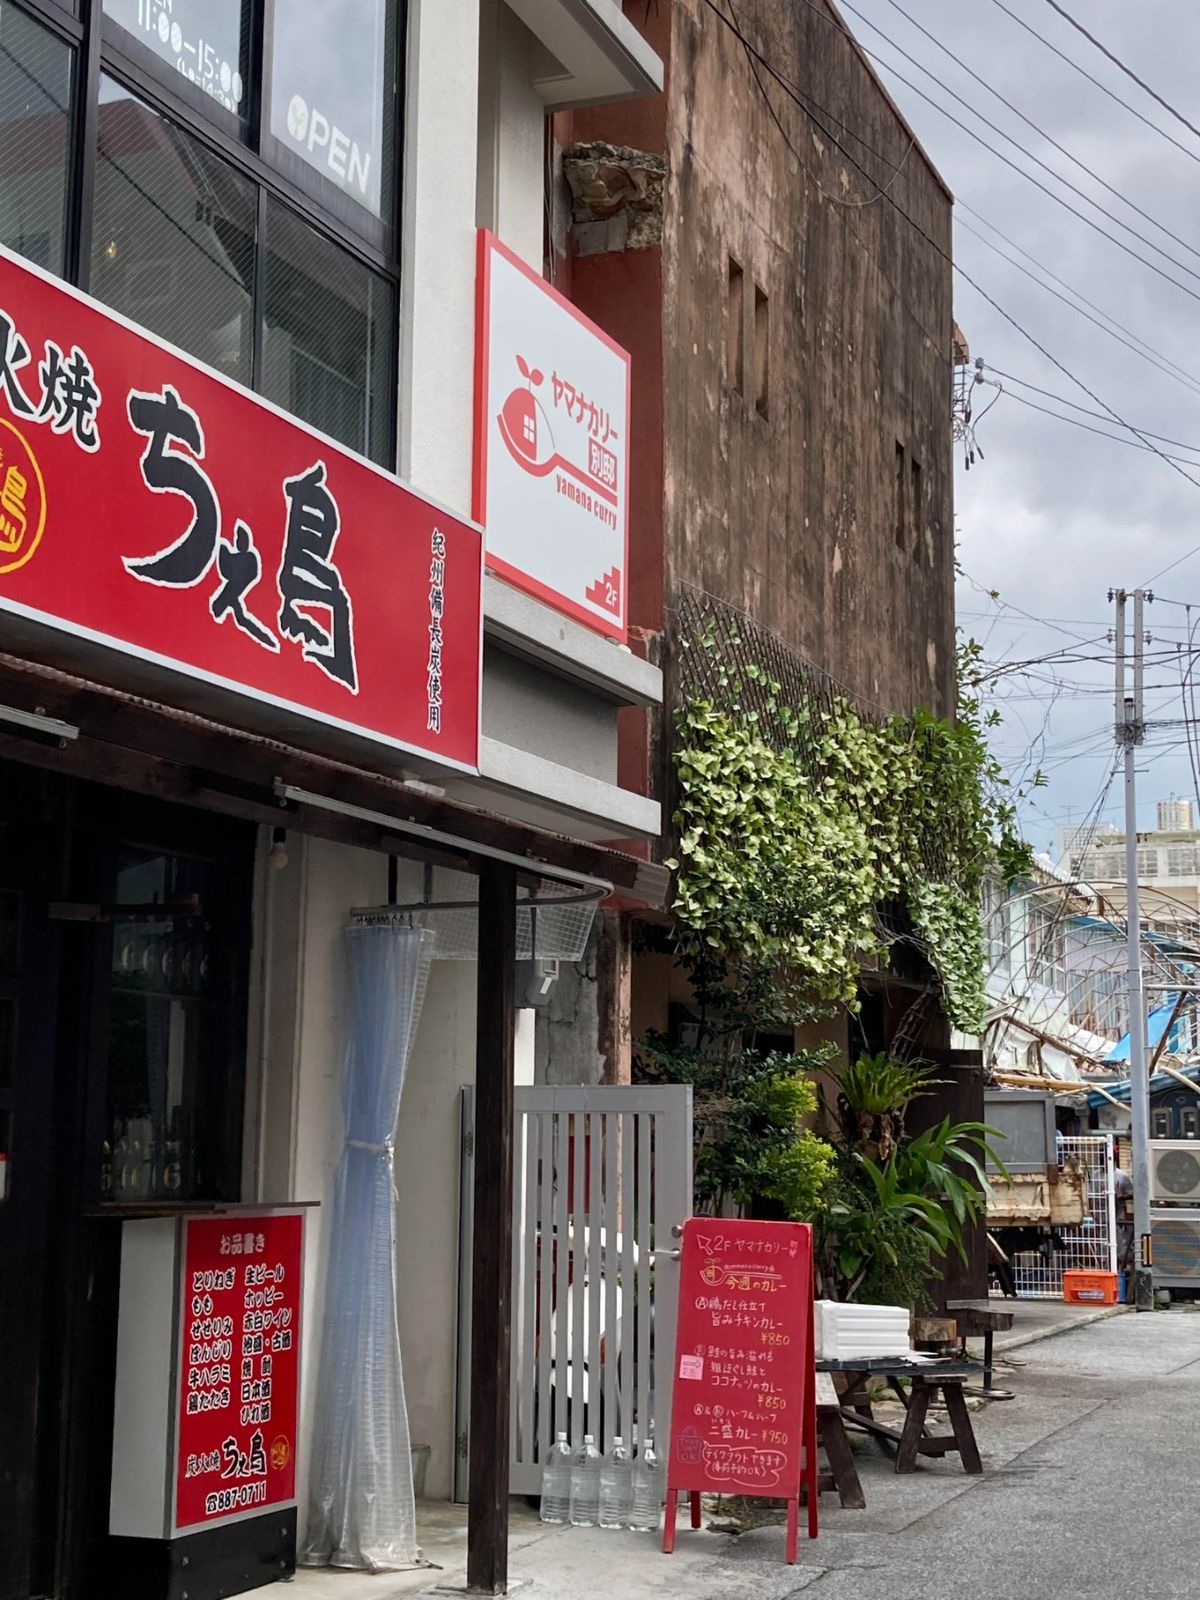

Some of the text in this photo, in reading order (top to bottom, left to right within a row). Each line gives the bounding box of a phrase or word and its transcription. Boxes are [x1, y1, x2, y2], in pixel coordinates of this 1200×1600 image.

[287, 94, 370, 194] OPEN
[551, 370, 618, 443] ヤマナカリー
[590, 440, 616, 488] 別邸
[556, 473, 617, 531] yamana curry
[605, 581, 618, 608] 2F
[427, 527, 446, 734] 紀州備長炭使用
[219, 1232, 266, 1256] お品書き
[713, 1235, 732, 1252] 2F
[193, 1267, 236, 1292] とりねぎ
[244, 1263, 285, 1286] 生ビール
[724, 1274, 787, 1293] 今週のカレー
[192, 1294, 213, 1317] もも
[244, 1285, 284, 1309] ホッピー
[190, 1315, 234, 1340] せせりみ
[243, 1307, 292, 1332] 赤白ワイン
[711, 1311, 784, 1330] 旨みチキンカレー
[760, 1331, 790, 1346] ¥850
[188, 1363, 231, 1389] 牛ハラミ
[711, 1374, 783, 1393] ココナッツのカレー
[241, 1377, 272, 1403] 日本酒
[757, 1393, 787, 1410] ¥850
[240, 1400, 272, 1427] ひれ酒
[761, 1429, 788, 1446] ¥950
[185, 1449, 221, 1478] 炭火焼
